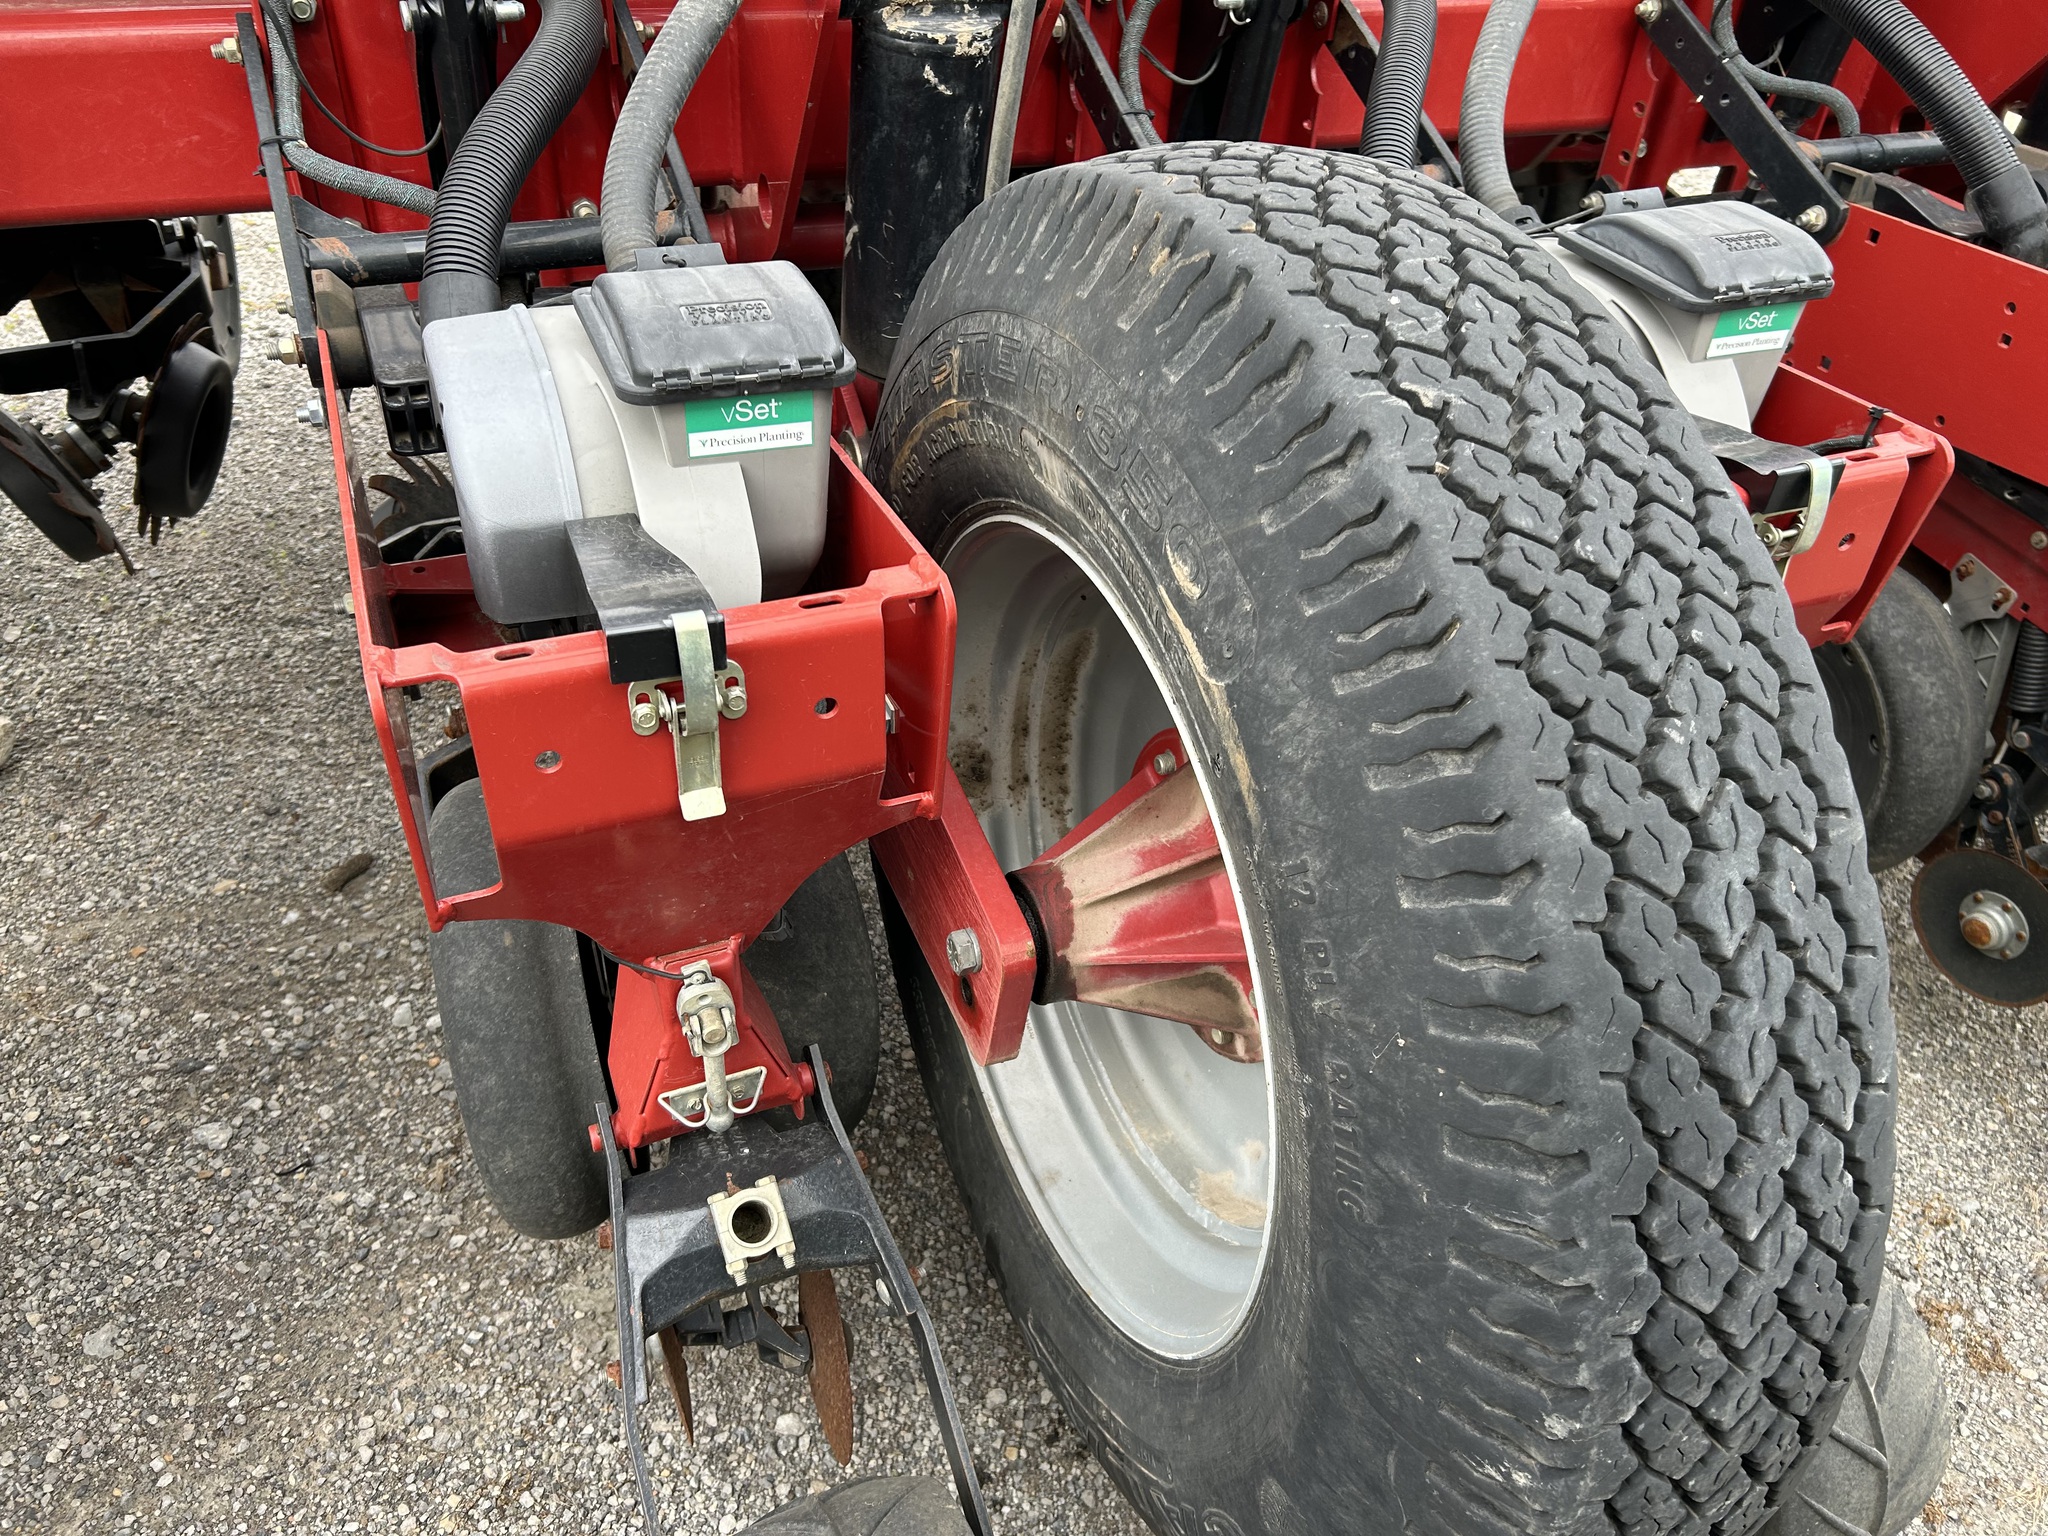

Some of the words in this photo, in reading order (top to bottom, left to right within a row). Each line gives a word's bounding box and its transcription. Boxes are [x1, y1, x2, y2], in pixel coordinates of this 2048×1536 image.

[685, 302, 767, 316] Precision
[691, 314, 771, 326] PLANTING
[1738, 311, 1776, 331] vSet
[1721, 340, 1752, 351] Precision
[1751, 336, 1780, 347] Planting
[721, 398, 779, 424] vSet
[710, 432, 757, 448] Precision
[759, 429, 804, 443] Planting
[900, 452, 925, 495] FOR
[923, 418, 1021, 463] AGRICULTURAL
[1086, 404, 1209, 600] 350
[1262, 909, 1284, 997] WARNING
[1324, 1060, 1367, 1224] RATING
